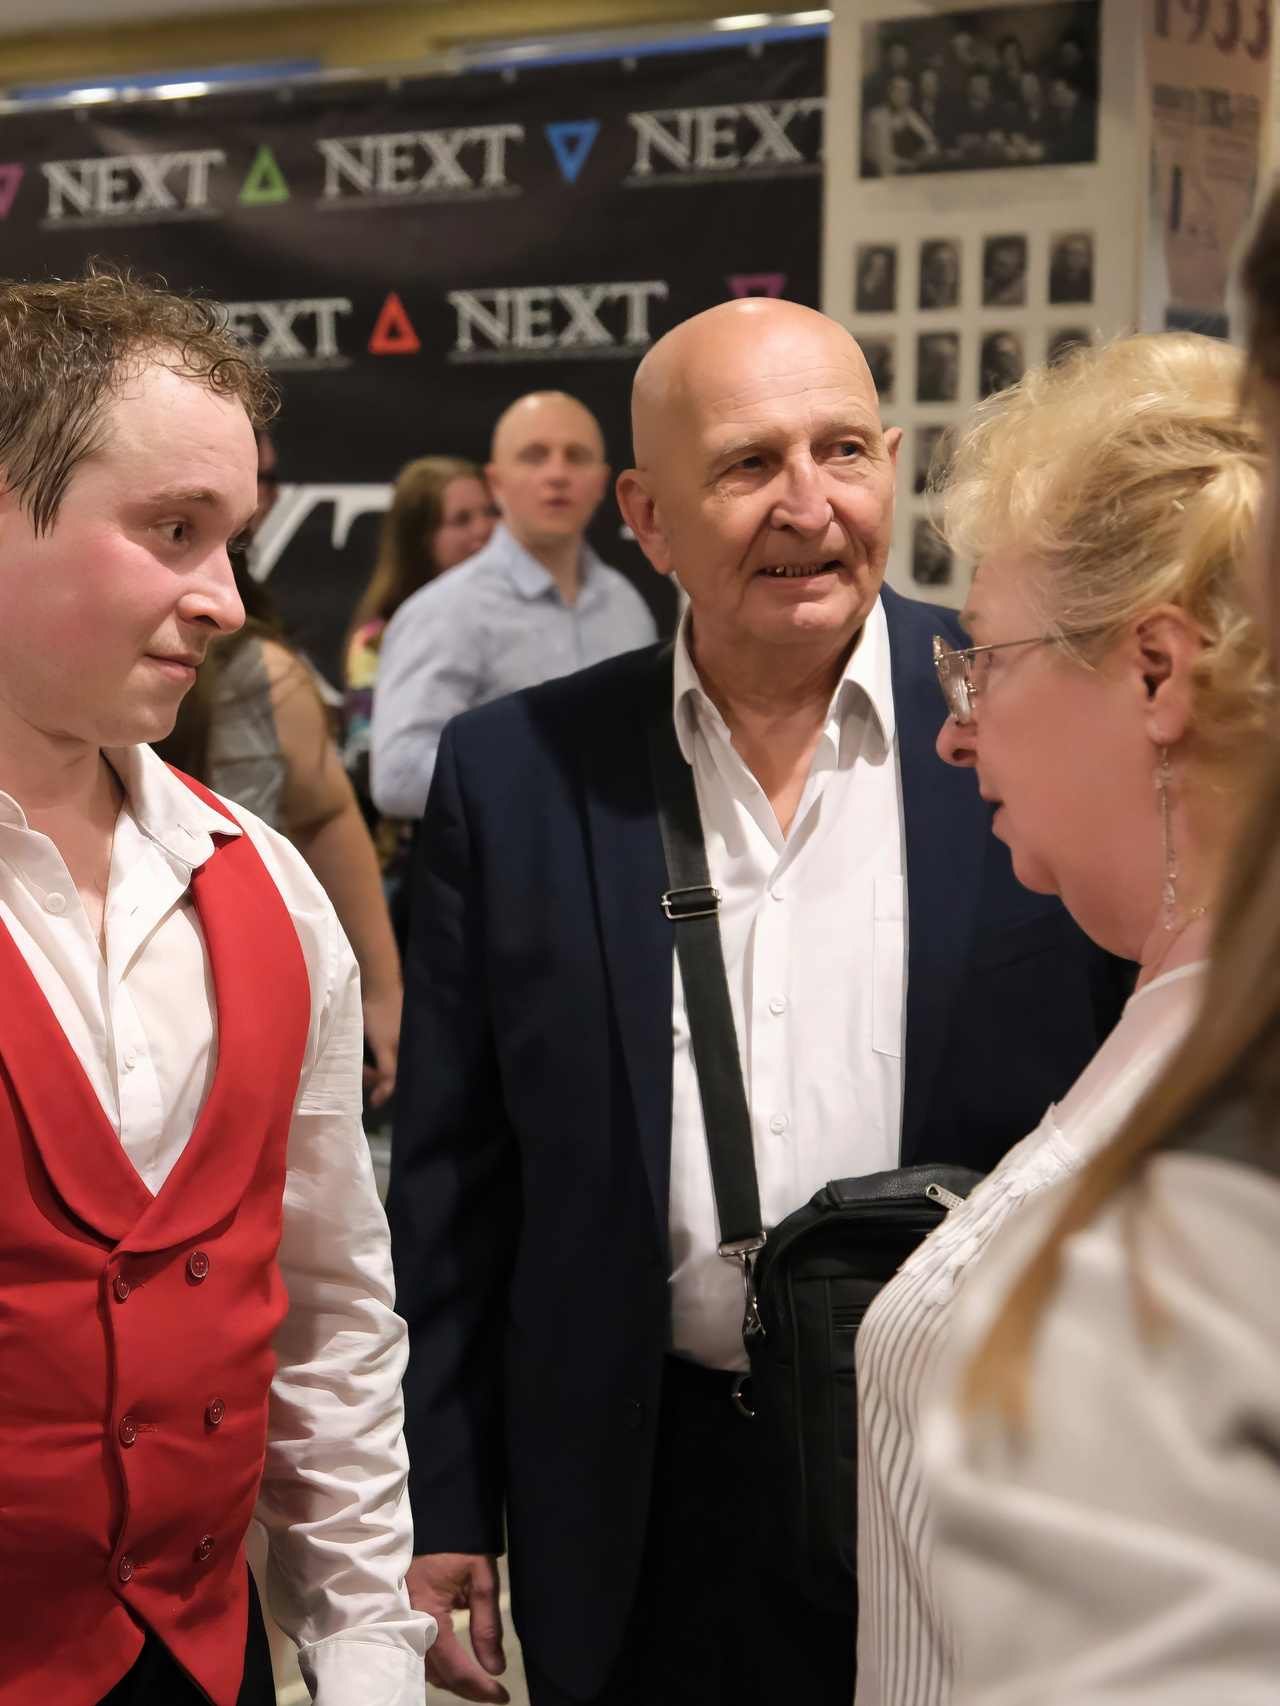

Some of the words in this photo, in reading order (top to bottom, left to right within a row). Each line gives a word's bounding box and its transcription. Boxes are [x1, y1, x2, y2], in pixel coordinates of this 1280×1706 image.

[41, 150, 225, 221] NEXT
[318, 123, 524, 196] NEXT
[219, 298, 352, 359] EXT
[448, 280, 669, 351] NEXT
